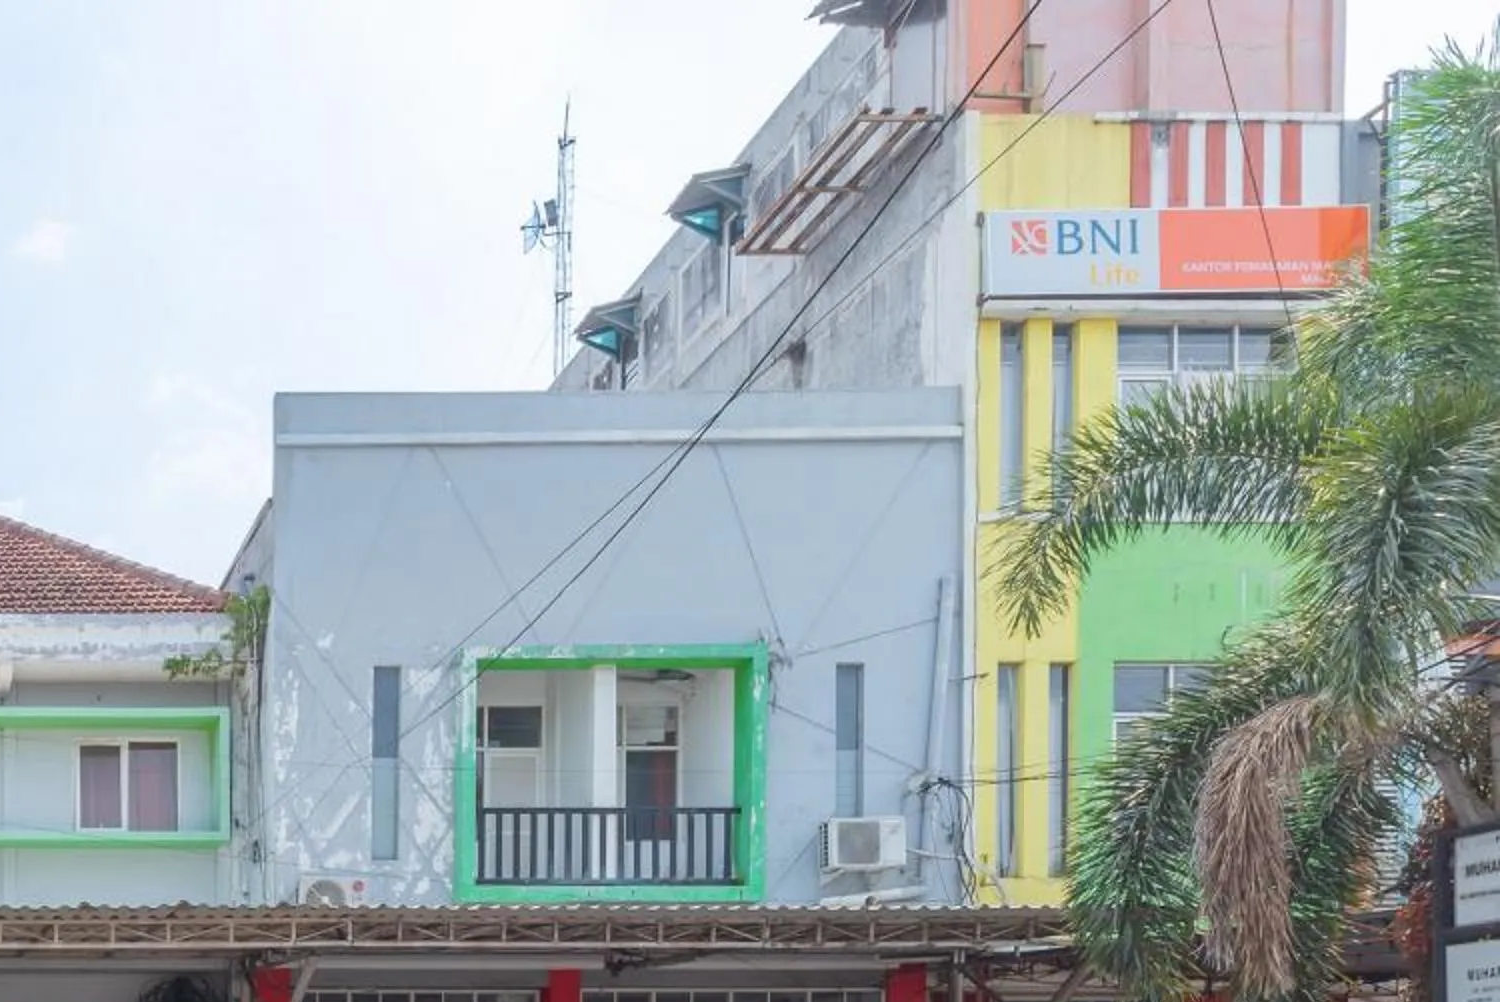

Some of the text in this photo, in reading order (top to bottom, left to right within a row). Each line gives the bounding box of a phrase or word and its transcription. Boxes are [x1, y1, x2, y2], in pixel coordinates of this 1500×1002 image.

[1056, 218, 1139, 256] BNI
[1090, 262, 1140, 287] Life
[1182, 260, 1233, 273] KANTOR
[1235, 260, 1308, 273] PEMASARAN
